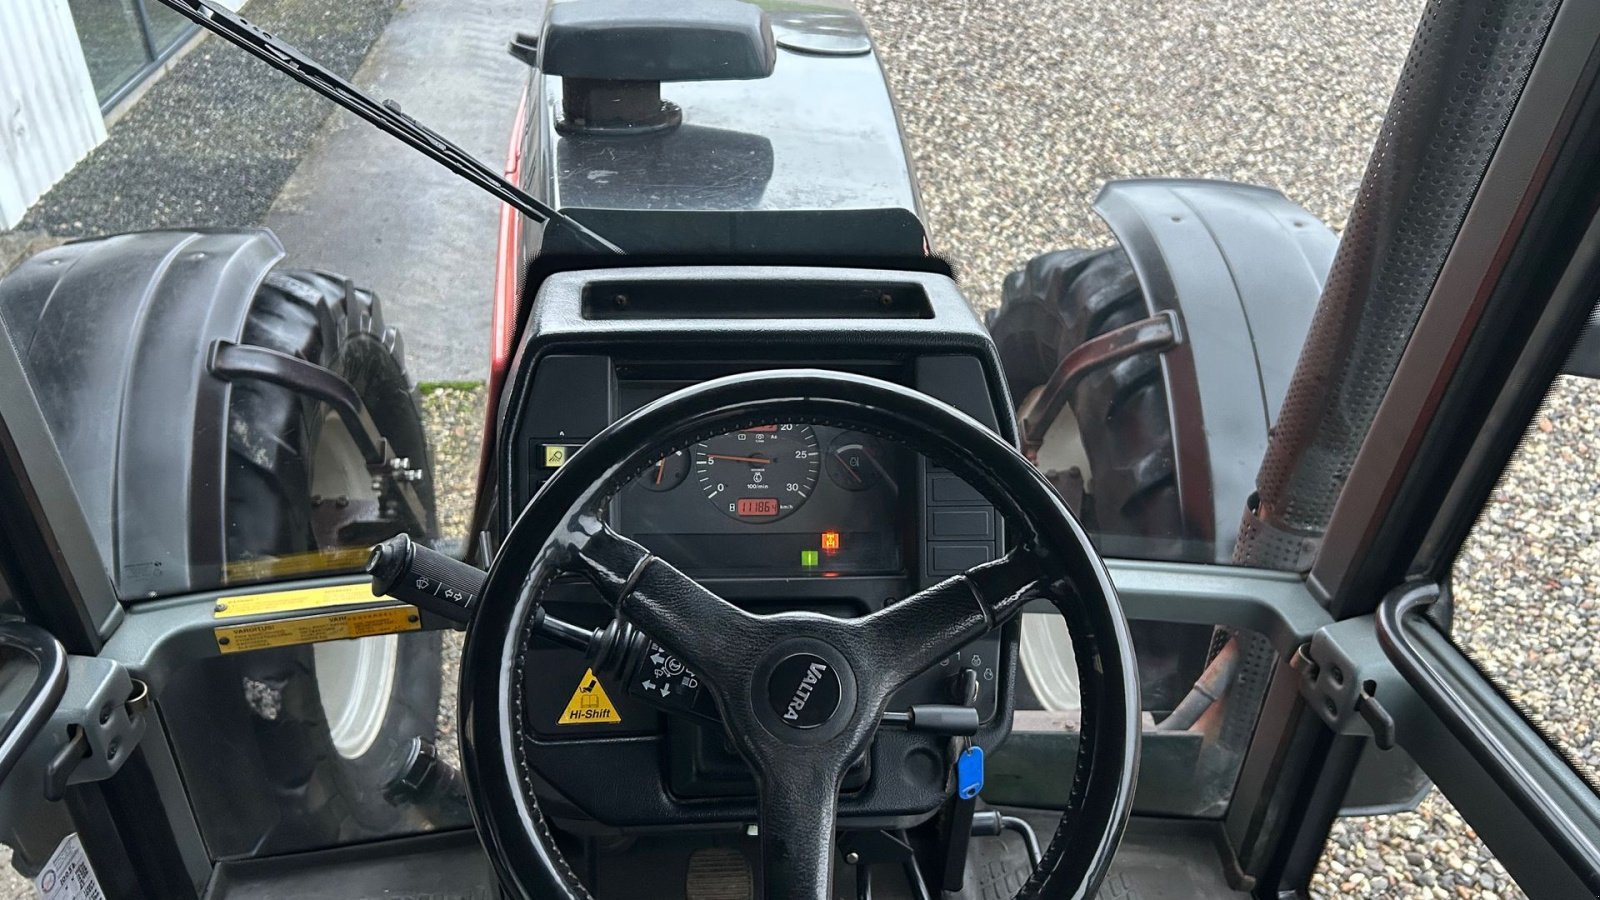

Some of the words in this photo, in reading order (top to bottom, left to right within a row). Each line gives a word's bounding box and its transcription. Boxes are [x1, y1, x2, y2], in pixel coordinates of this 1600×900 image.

[781, 423, 793, 431] 20
[795, 450, 807, 459] 25
[708, 456, 715, 465] 5
[717, 483, 724, 492] 0
[786, 483, 799, 491] 30
[783, 662, 827, 720] VALTRA
[569, 708, 611, 720] Hi-Shift
